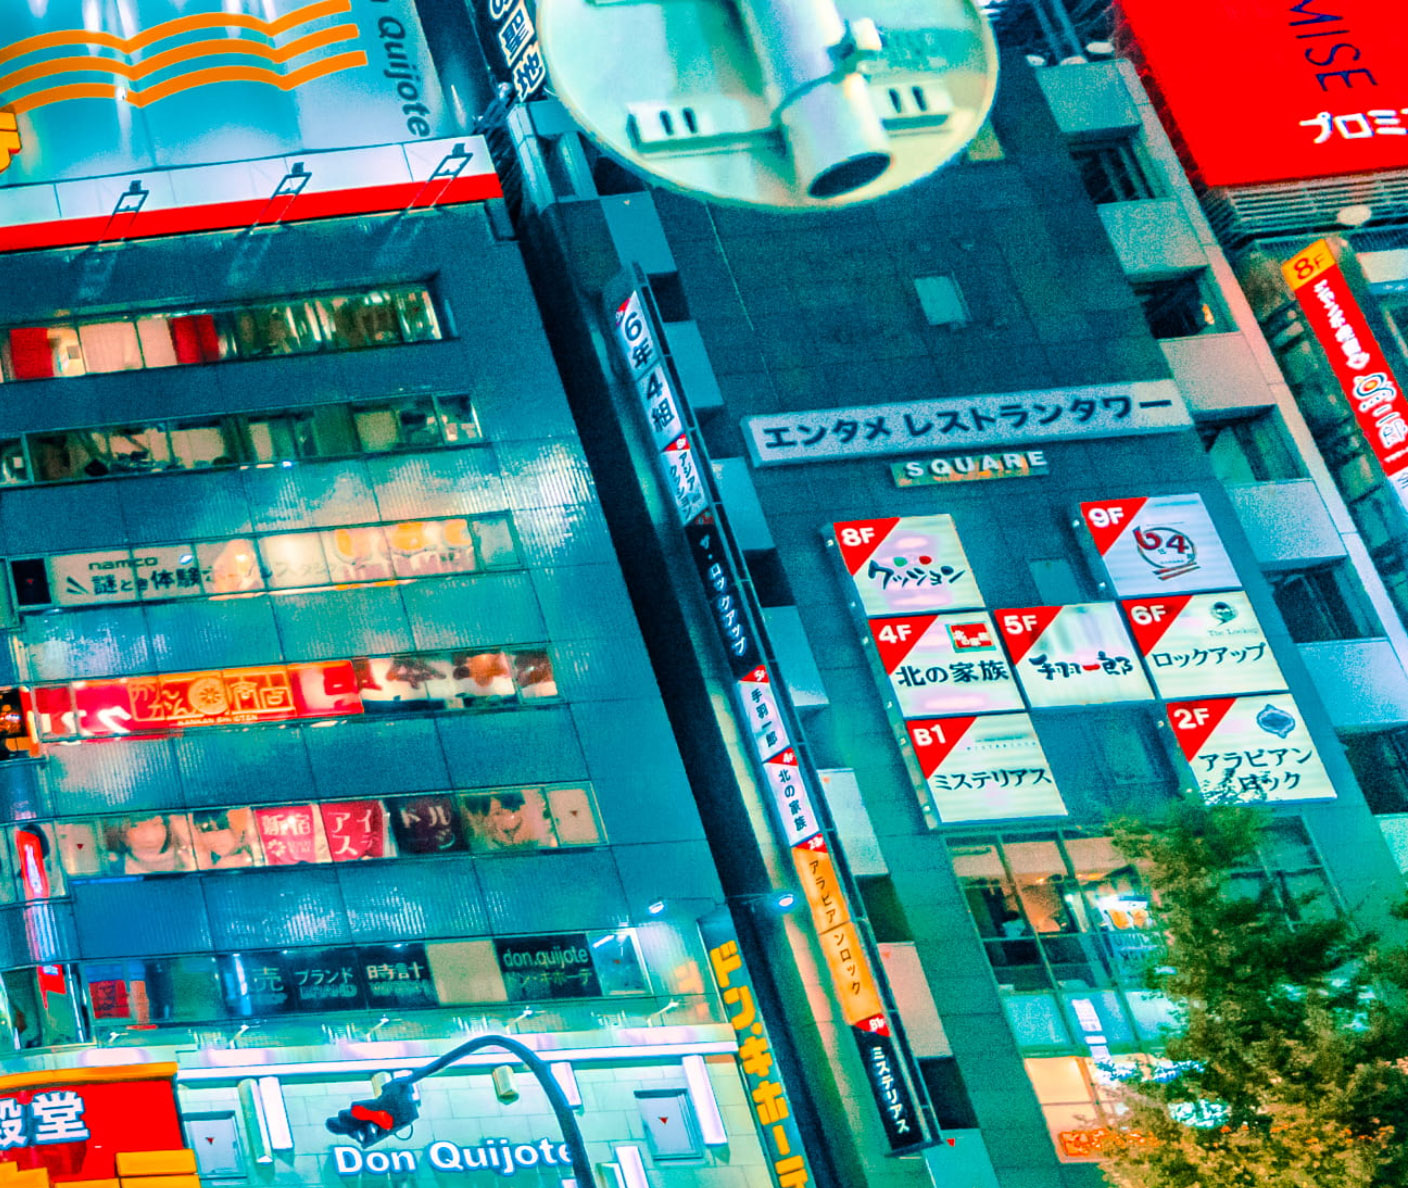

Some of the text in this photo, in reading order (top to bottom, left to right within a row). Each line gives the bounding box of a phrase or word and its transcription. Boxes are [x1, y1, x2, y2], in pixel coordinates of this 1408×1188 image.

[375, 15, 432, 138] Quijote
[1293, 252, 1327, 281] 8F
[764, 397, 1174, 450] エンタメ レストランタワー
[905, 450, 1048, 479] SQUARE
[1088, 506, 1125, 528] 9F
[841, 526, 877, 547] 8F
[89, 556, 159, 570] namco
[868, 560, 966, 590] クッション
[699, 533, 747, 657] ザ・ロックアップ
[1004, 613, 1038, 635] 5F
[1130, 604, 1166, 626] 6F
[879, 622, 913, 644] 4F
[1029, 650, 1134, 681] 手羽一郎
[1152, 642, 1267, 669] ロックアップ
[898, 660, 1011, 687] 北の家族
[750, 685, 778, 748] 手羽一郎
[1173, 708, 1210, 730] 2F
[913, 723, 947, 746] B1
[1198, 748, 1313, 773] アラビアン
[934, 768, 1053, 792] ミステリアス
[778, 768, 808, 832] 北の家族
[807, 858, 862, 996] アラビアンロック
[367, 961, 425, 980] 時計
[502, 946, 589, 970] don.quijote
[294, 966, 354, 986] ブランド
[873, 1046, 911, 1135] ミステリアス
[333, 1136, 577, 1176] Don Quijote
